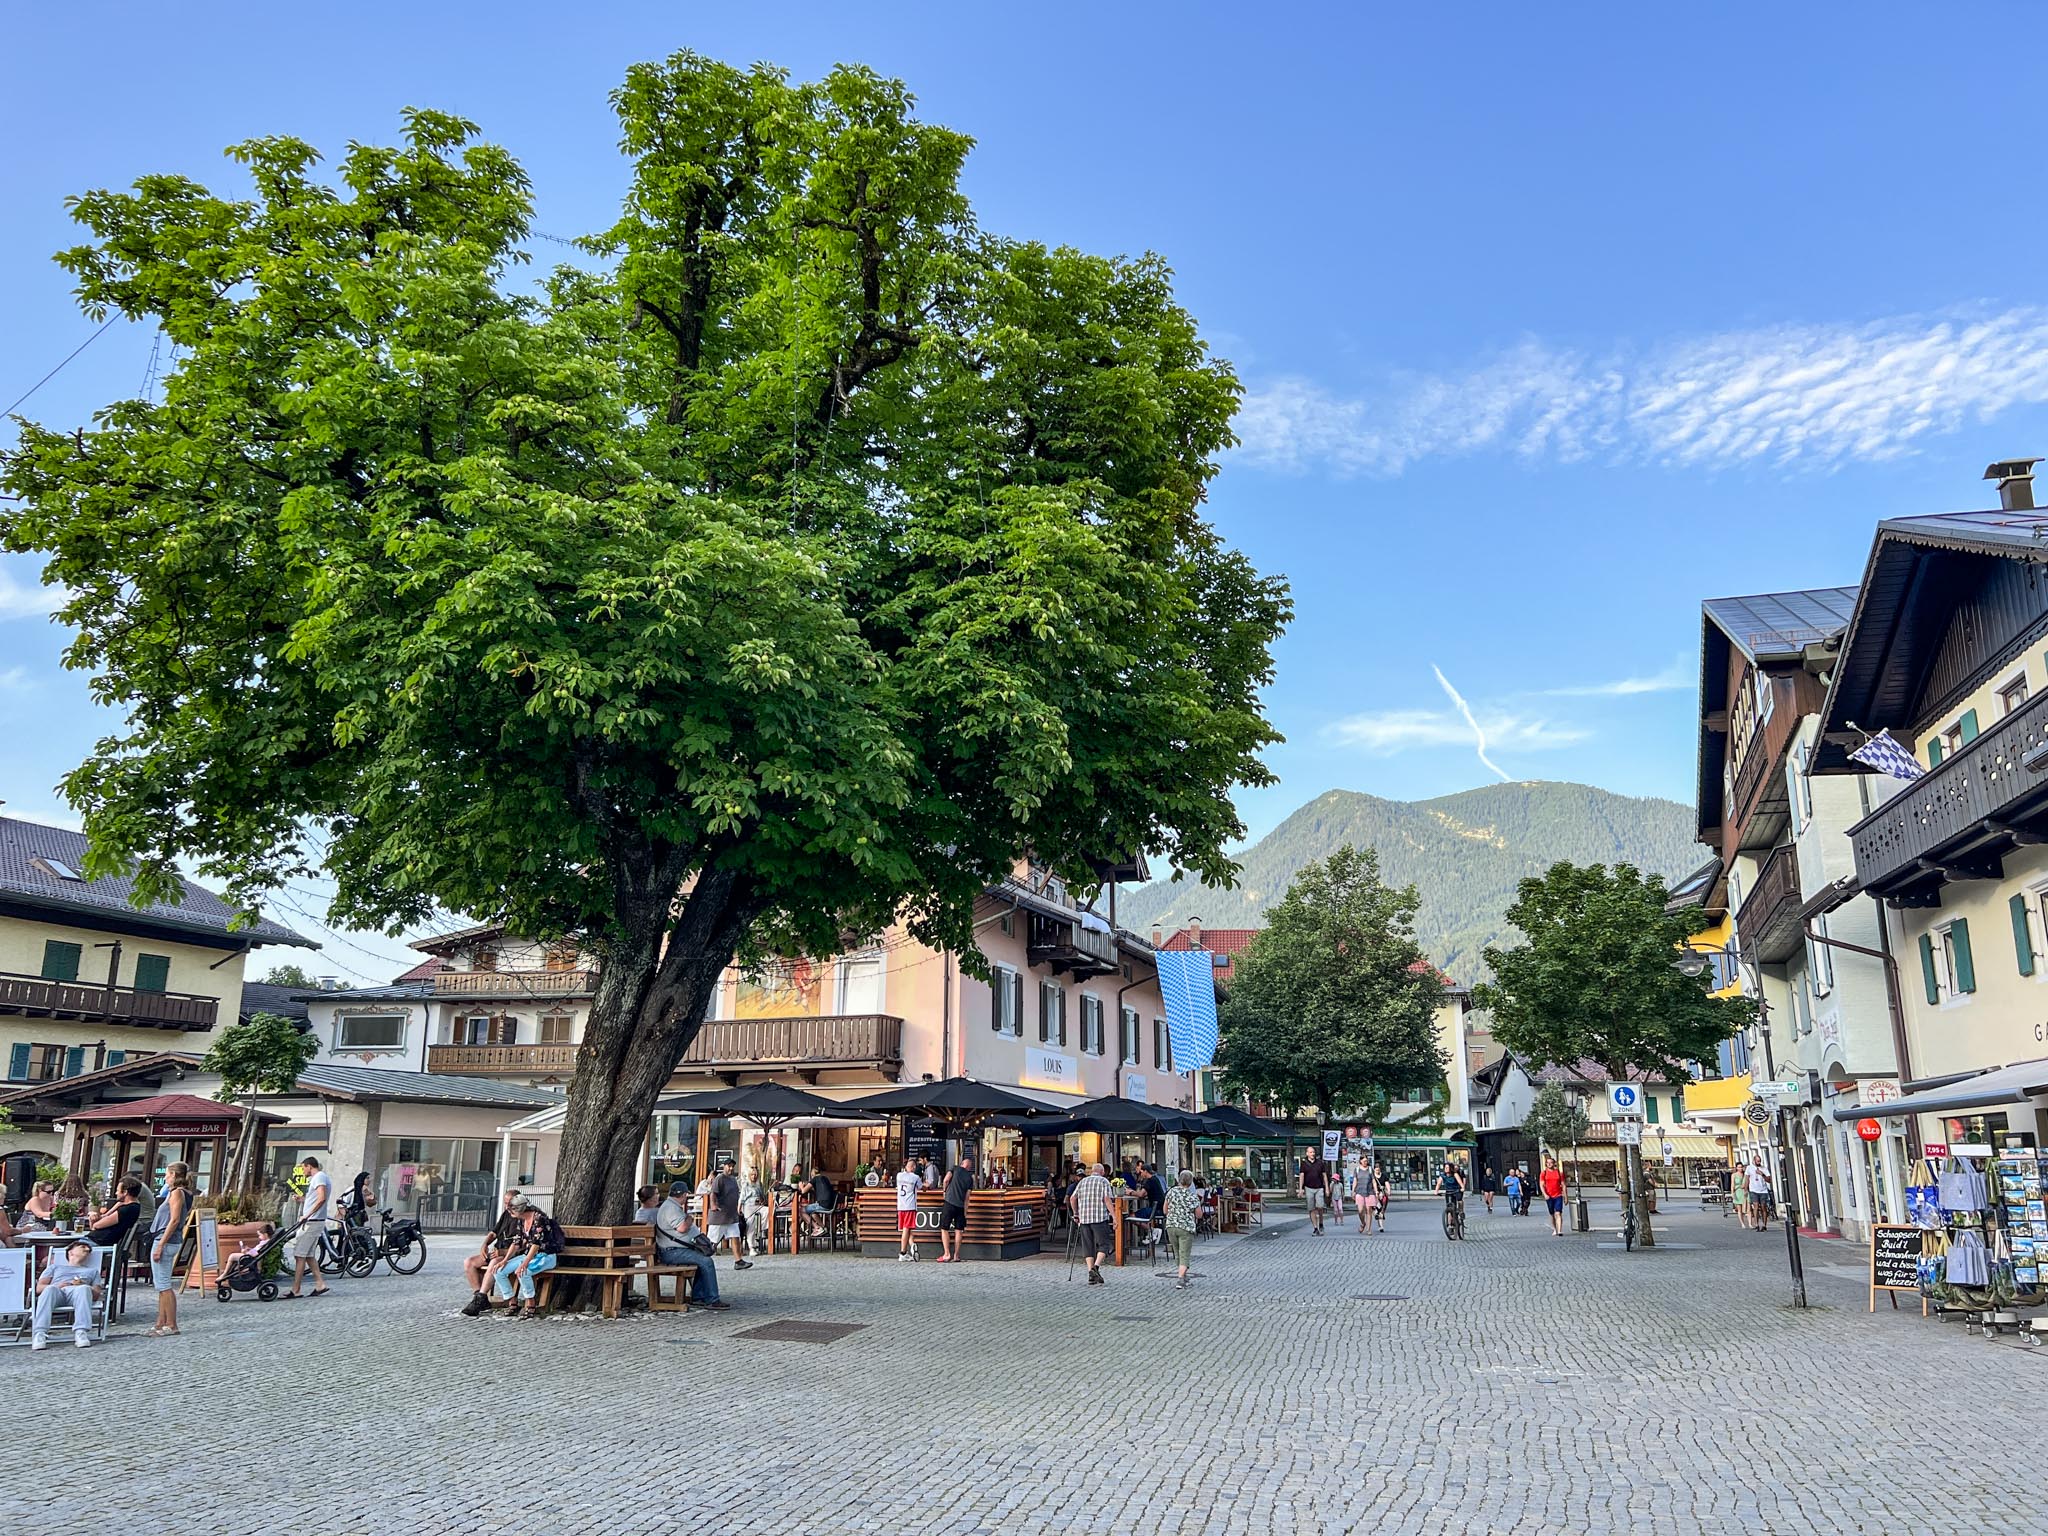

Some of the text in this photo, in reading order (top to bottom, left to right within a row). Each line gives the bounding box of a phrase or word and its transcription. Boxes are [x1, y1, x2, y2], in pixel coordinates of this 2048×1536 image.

[1043, 1057, 1062, 1074] LOUIS
[201, 1124, 220, 1133] BAR
[900, 1184, 907, 1197] 5
[1014, 1209, 1032, 1226] LOUIS
[1876, 1259, 1892, 1268] und
